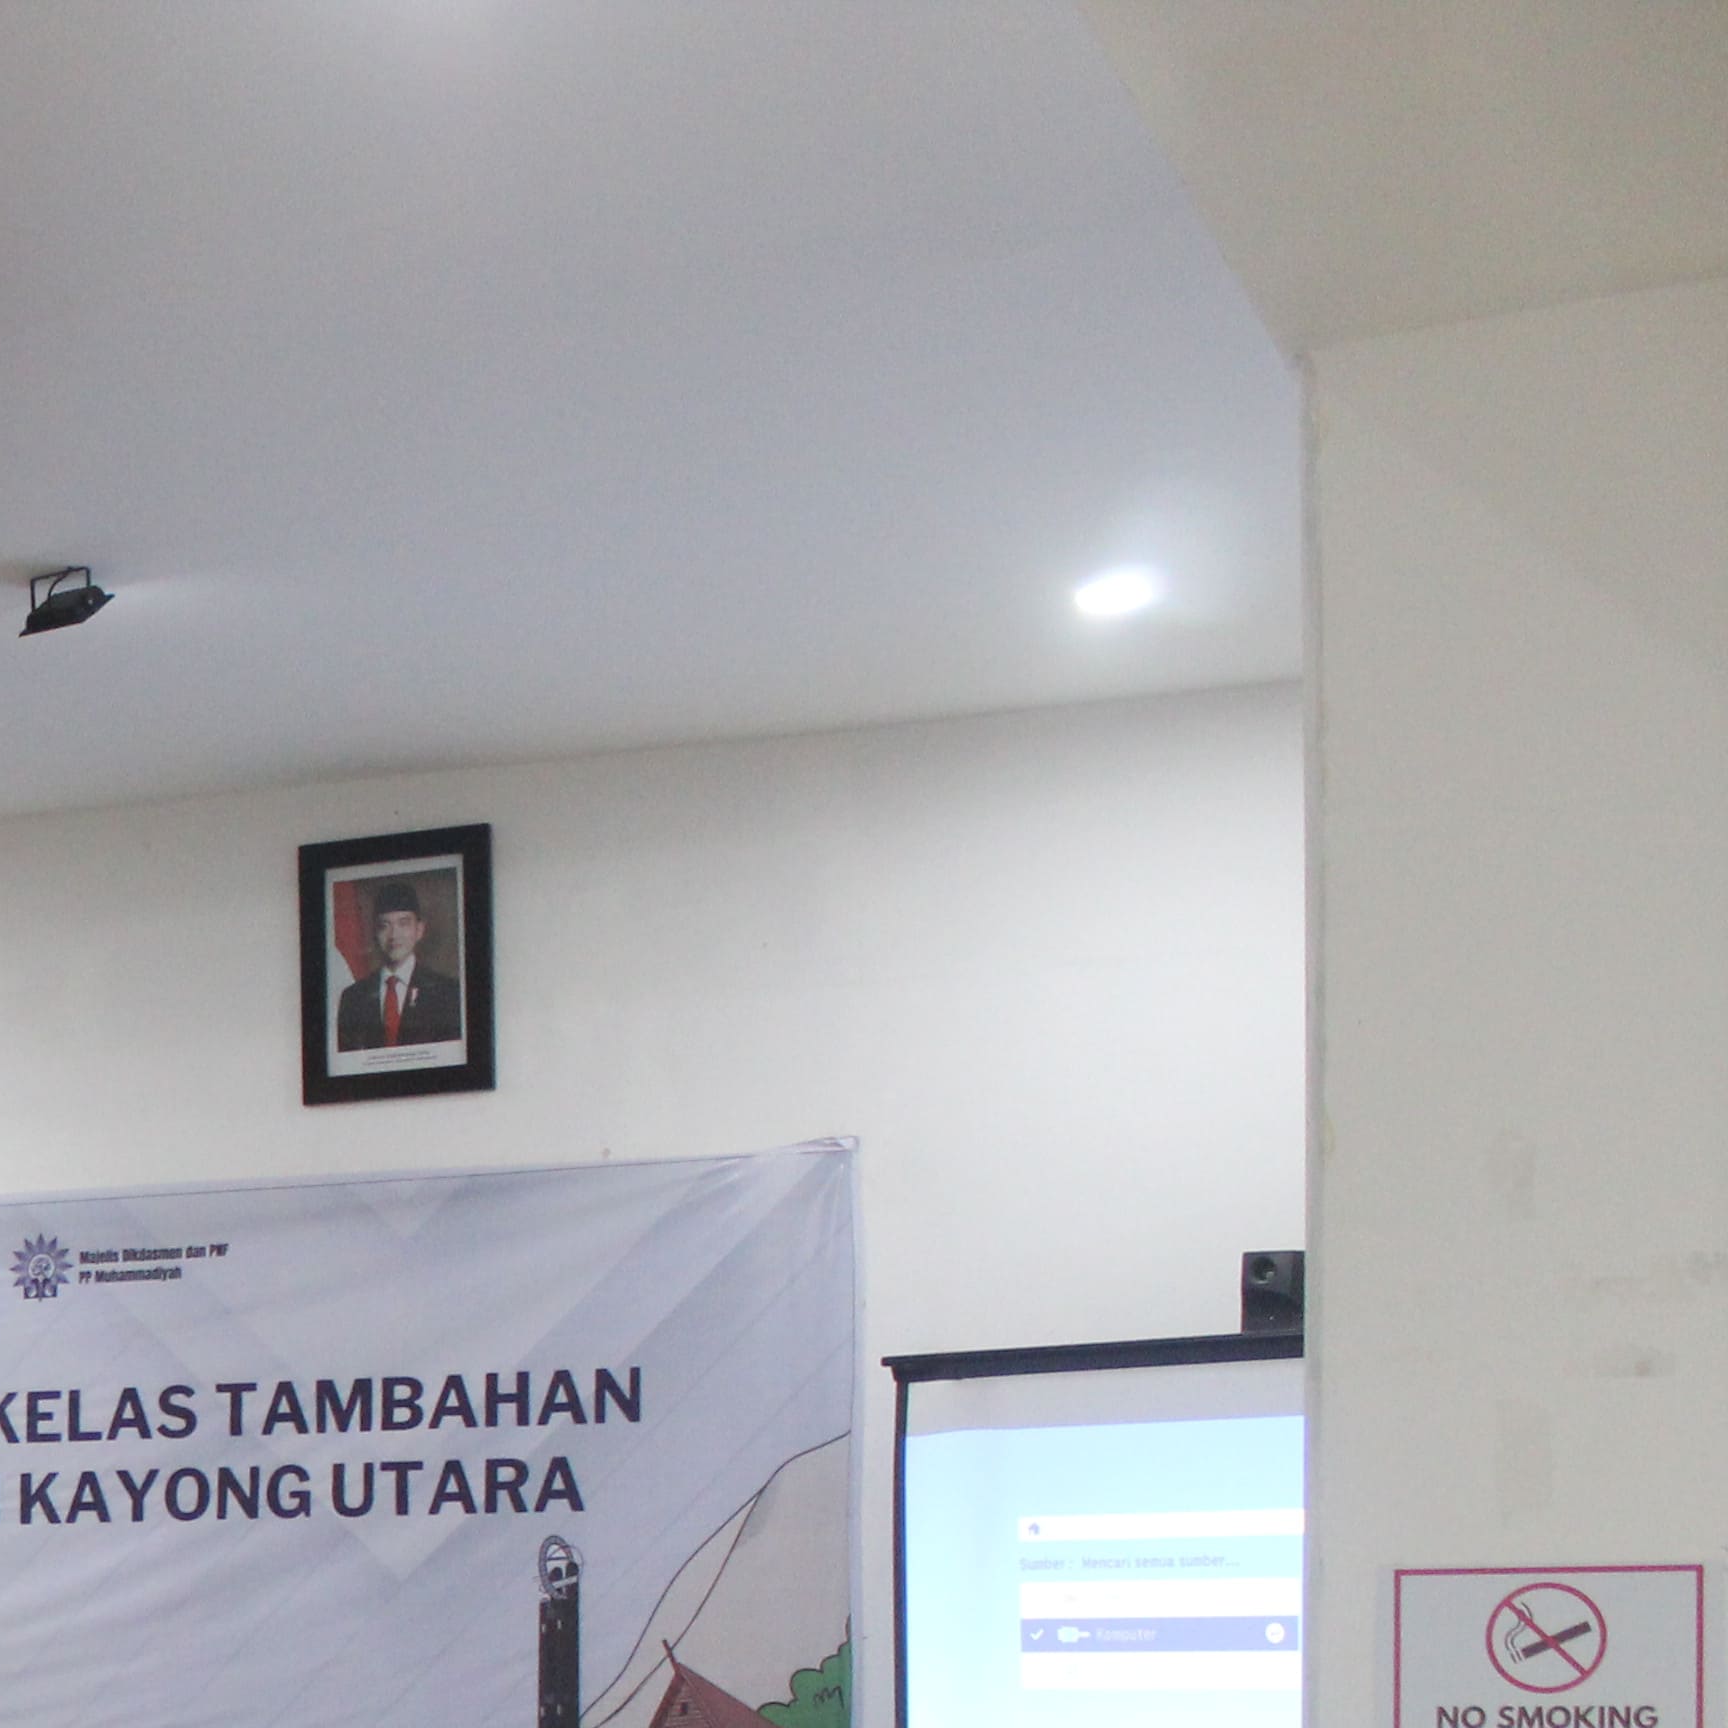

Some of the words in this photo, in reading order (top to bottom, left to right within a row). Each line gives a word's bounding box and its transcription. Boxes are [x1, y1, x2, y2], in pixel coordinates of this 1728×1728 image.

[216, 1366, 642, 1436] TAMBAHAN
[19, 1464, 312, 1525] KAYONG
[331, 1456, 585, 1517] UTARA
